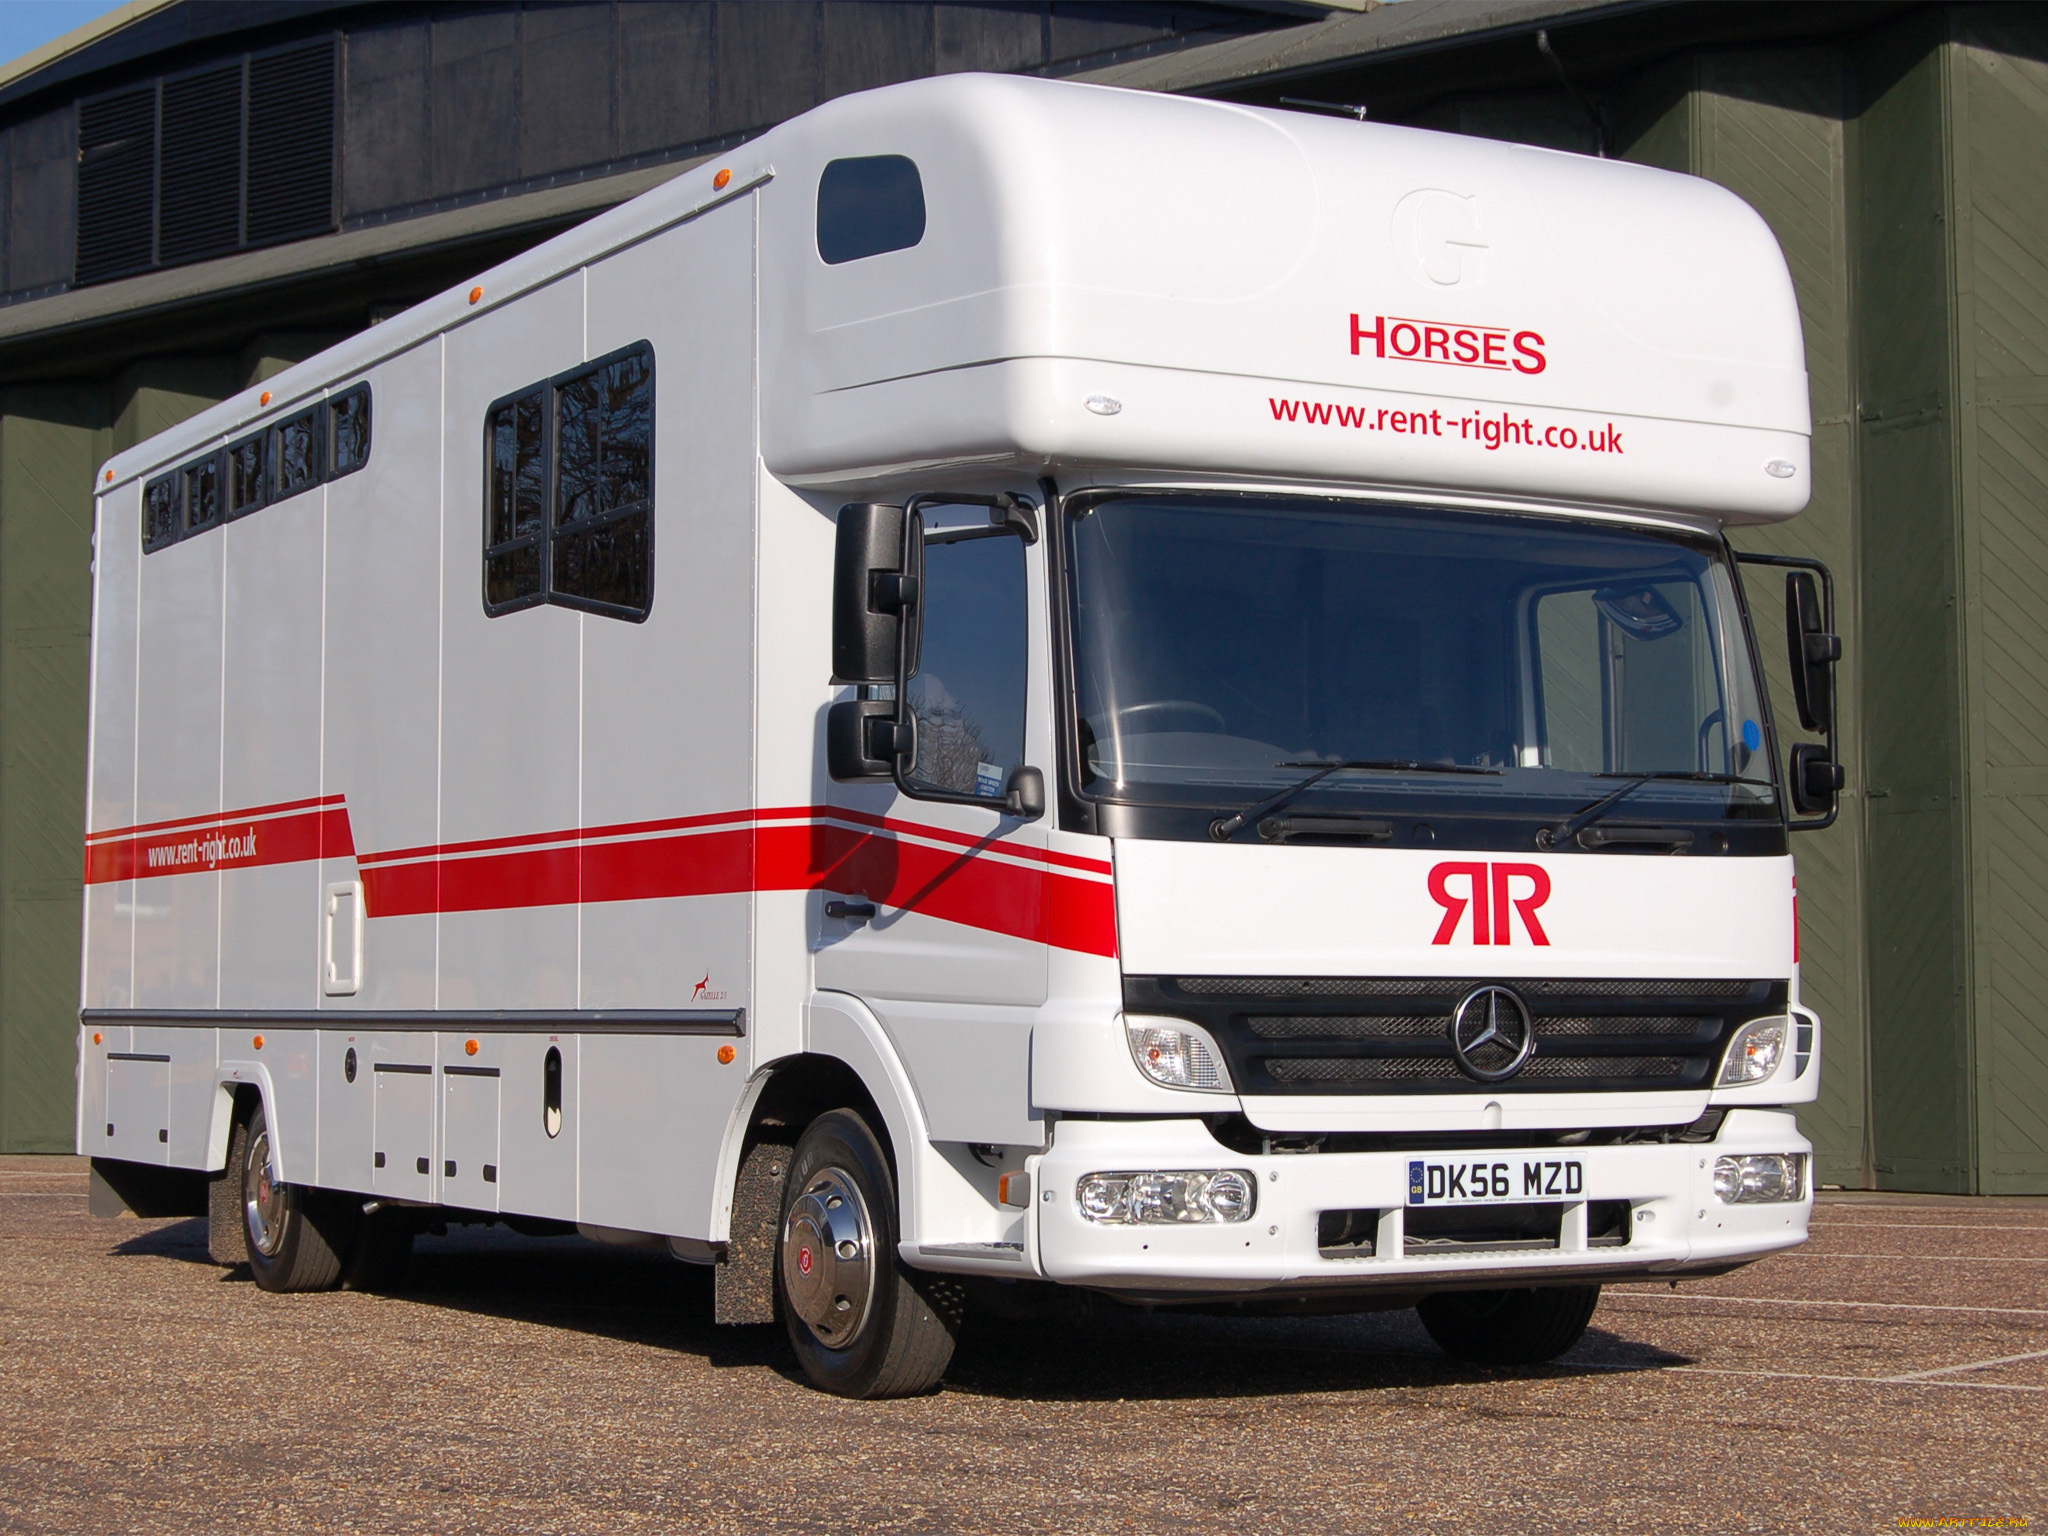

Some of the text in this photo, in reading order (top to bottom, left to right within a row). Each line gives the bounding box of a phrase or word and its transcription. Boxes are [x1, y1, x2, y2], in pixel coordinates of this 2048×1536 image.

[1390, 187, 1489, 291] G
[1350, 313, 1547, 375] HORSES
[1268, 397, 1624, 454] www.rent-right.co.uk
[147, 826, 257, 869] www.rent-right.co.uk
[1411, 1185, 1423, 1194] GB
[1427, 1161, 1583, 1199] DK56 MZD
